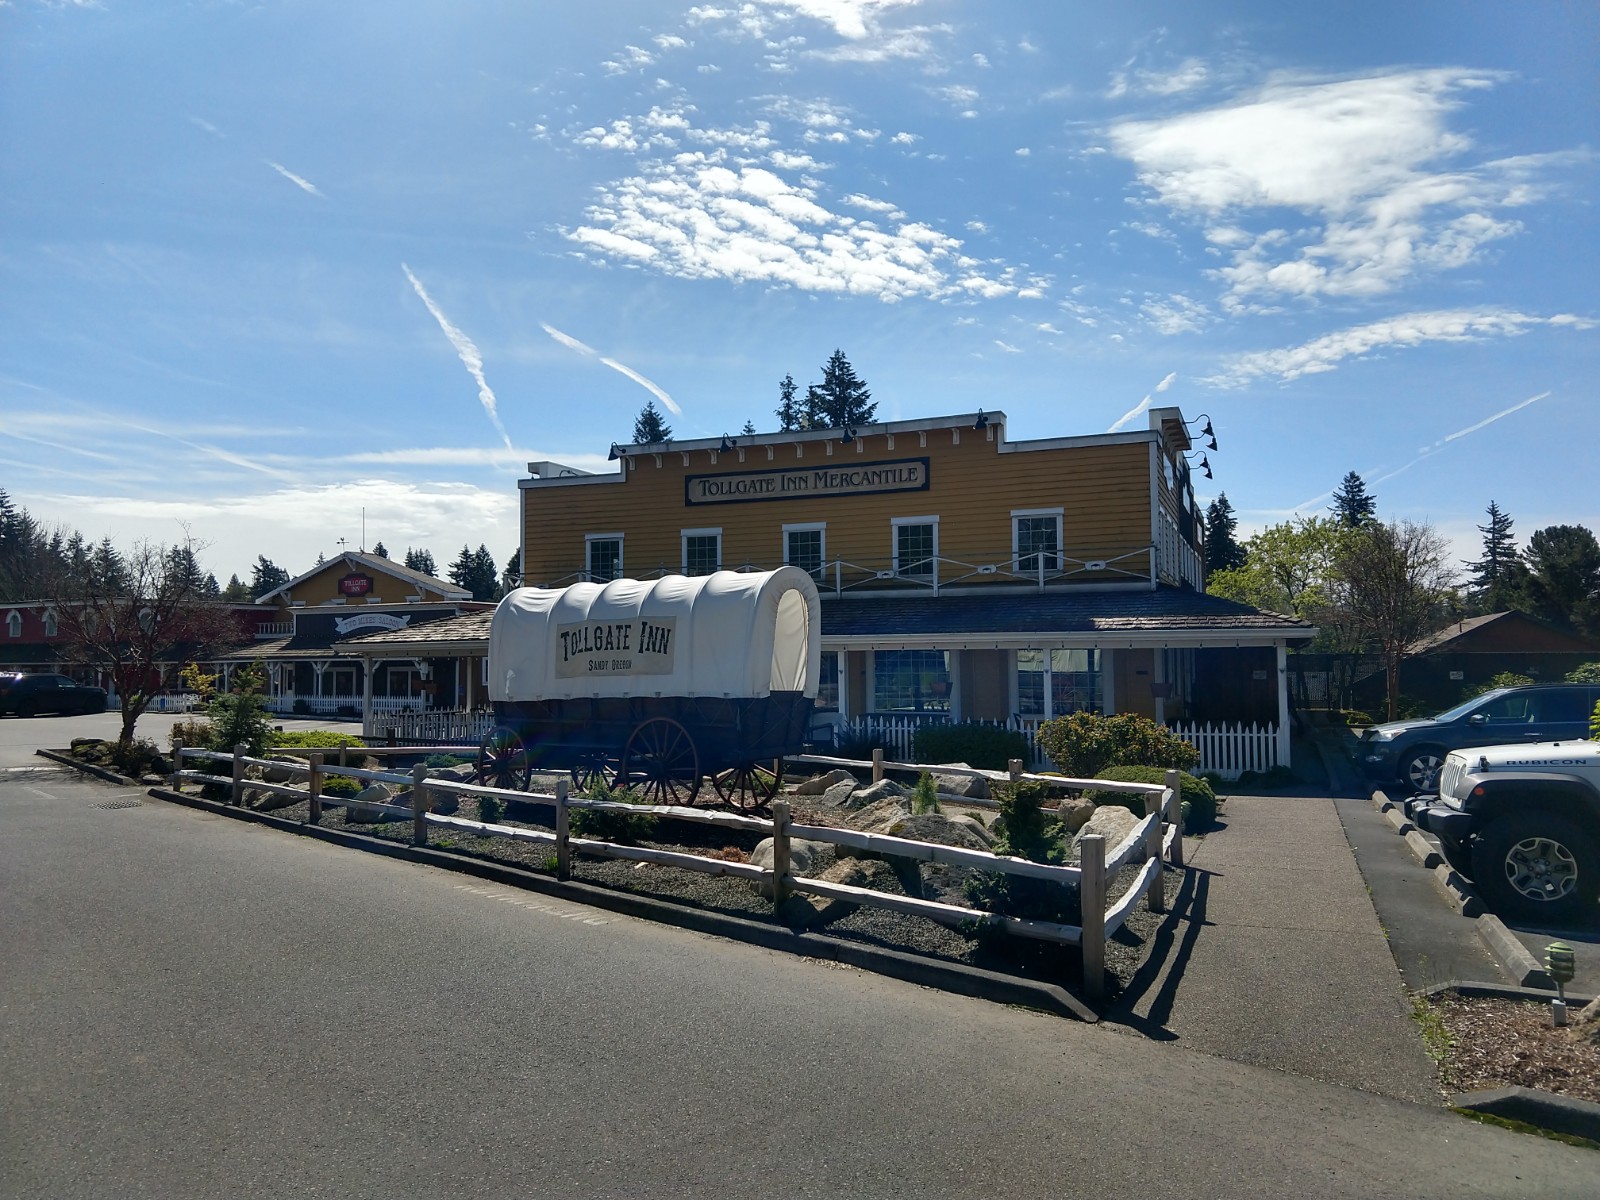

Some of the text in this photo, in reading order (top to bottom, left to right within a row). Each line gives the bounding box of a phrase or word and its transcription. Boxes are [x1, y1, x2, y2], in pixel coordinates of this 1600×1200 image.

[698, 467, 919, 497] TOLLGATE INN MERCANTILE
[560, 621, 672, 662] TOLLGATE INN
[588, 659, 633, 672] SANDY OREGON
